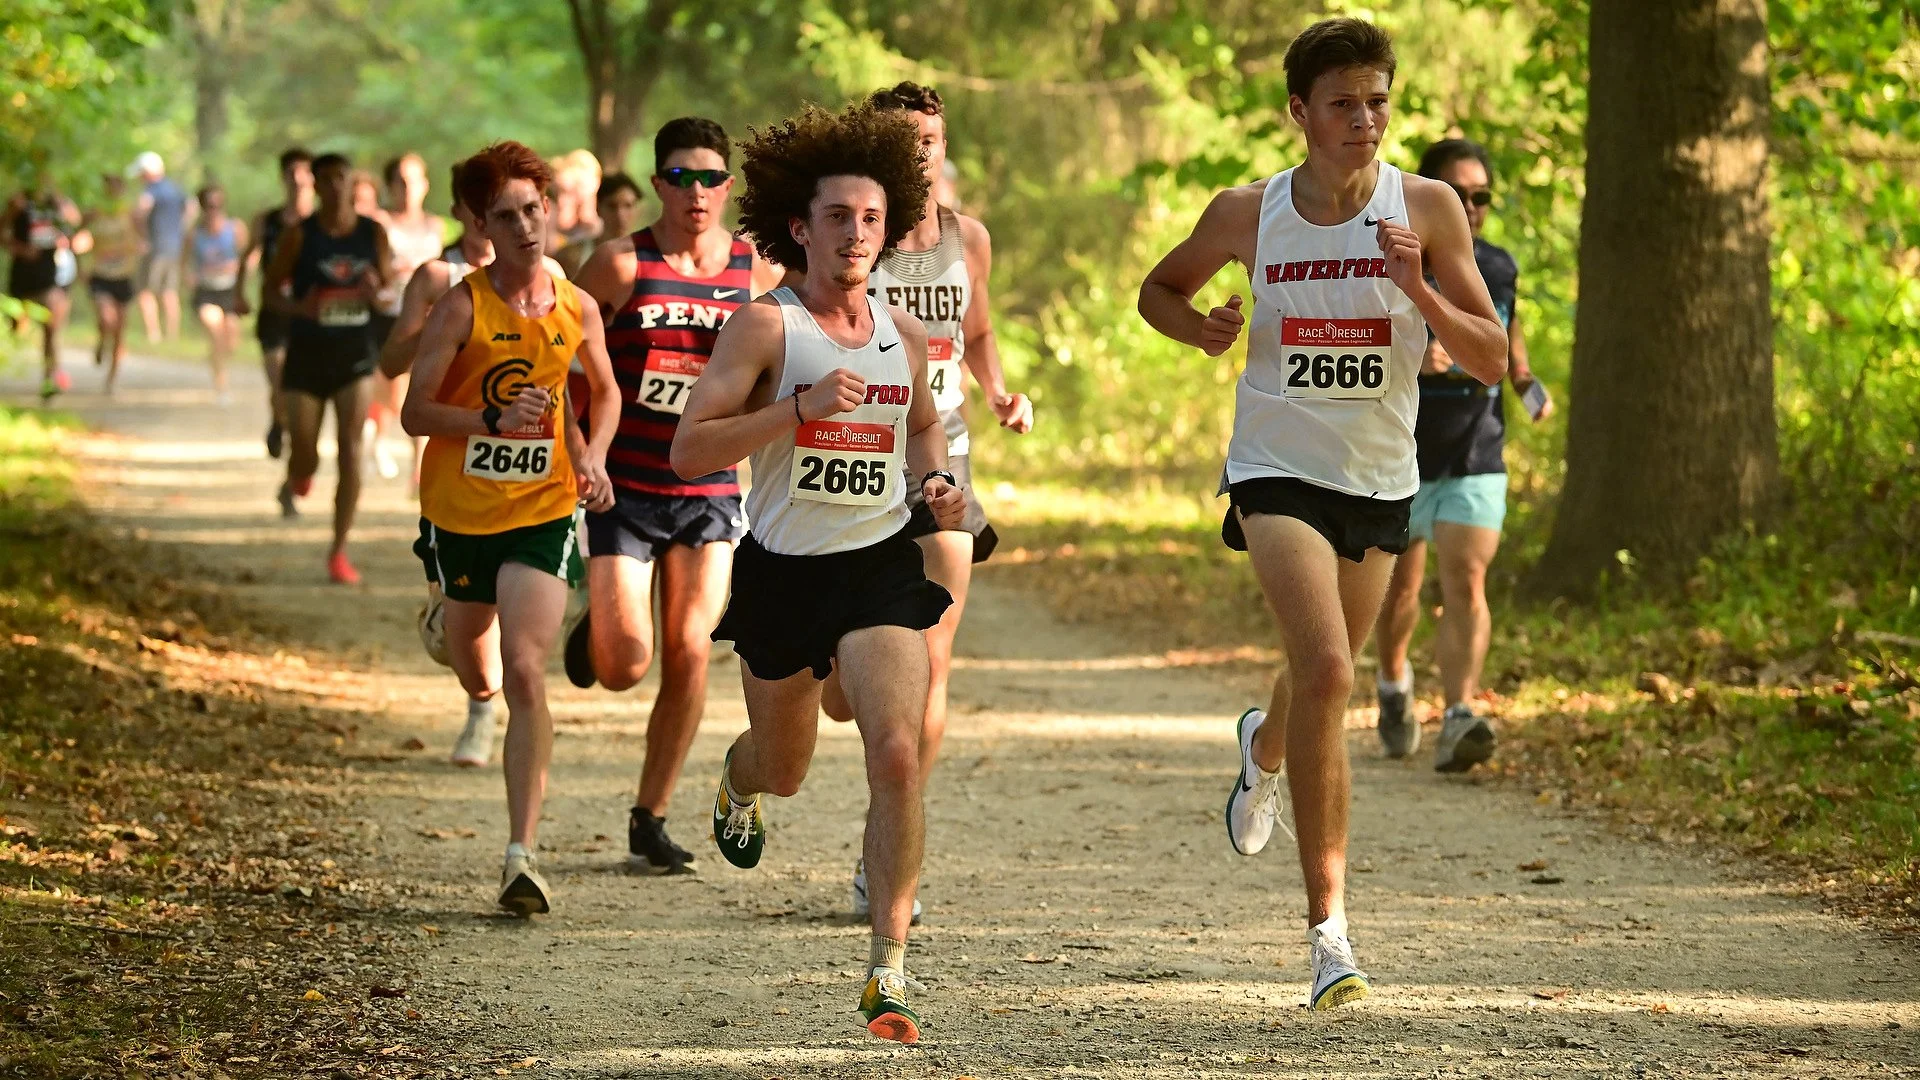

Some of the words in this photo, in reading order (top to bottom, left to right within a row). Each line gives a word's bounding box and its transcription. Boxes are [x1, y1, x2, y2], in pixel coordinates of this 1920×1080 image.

[1265, 257, 1390, 285] HAVERFOR
[867, 285, 963, 323] EHIGH
[1298, 327, 1325, 338] RACE
[1337, 328, 1374, 338] RESULT
[1287, 353, 1384, 389] 2666
[645, 378, 693, 406] 27
[815, 430, 841, 442] RACE
[852, 433, 882, 444] RESULT
[471, 441, 548, 474] 2646
[797, 455, 887, 497] 2665
